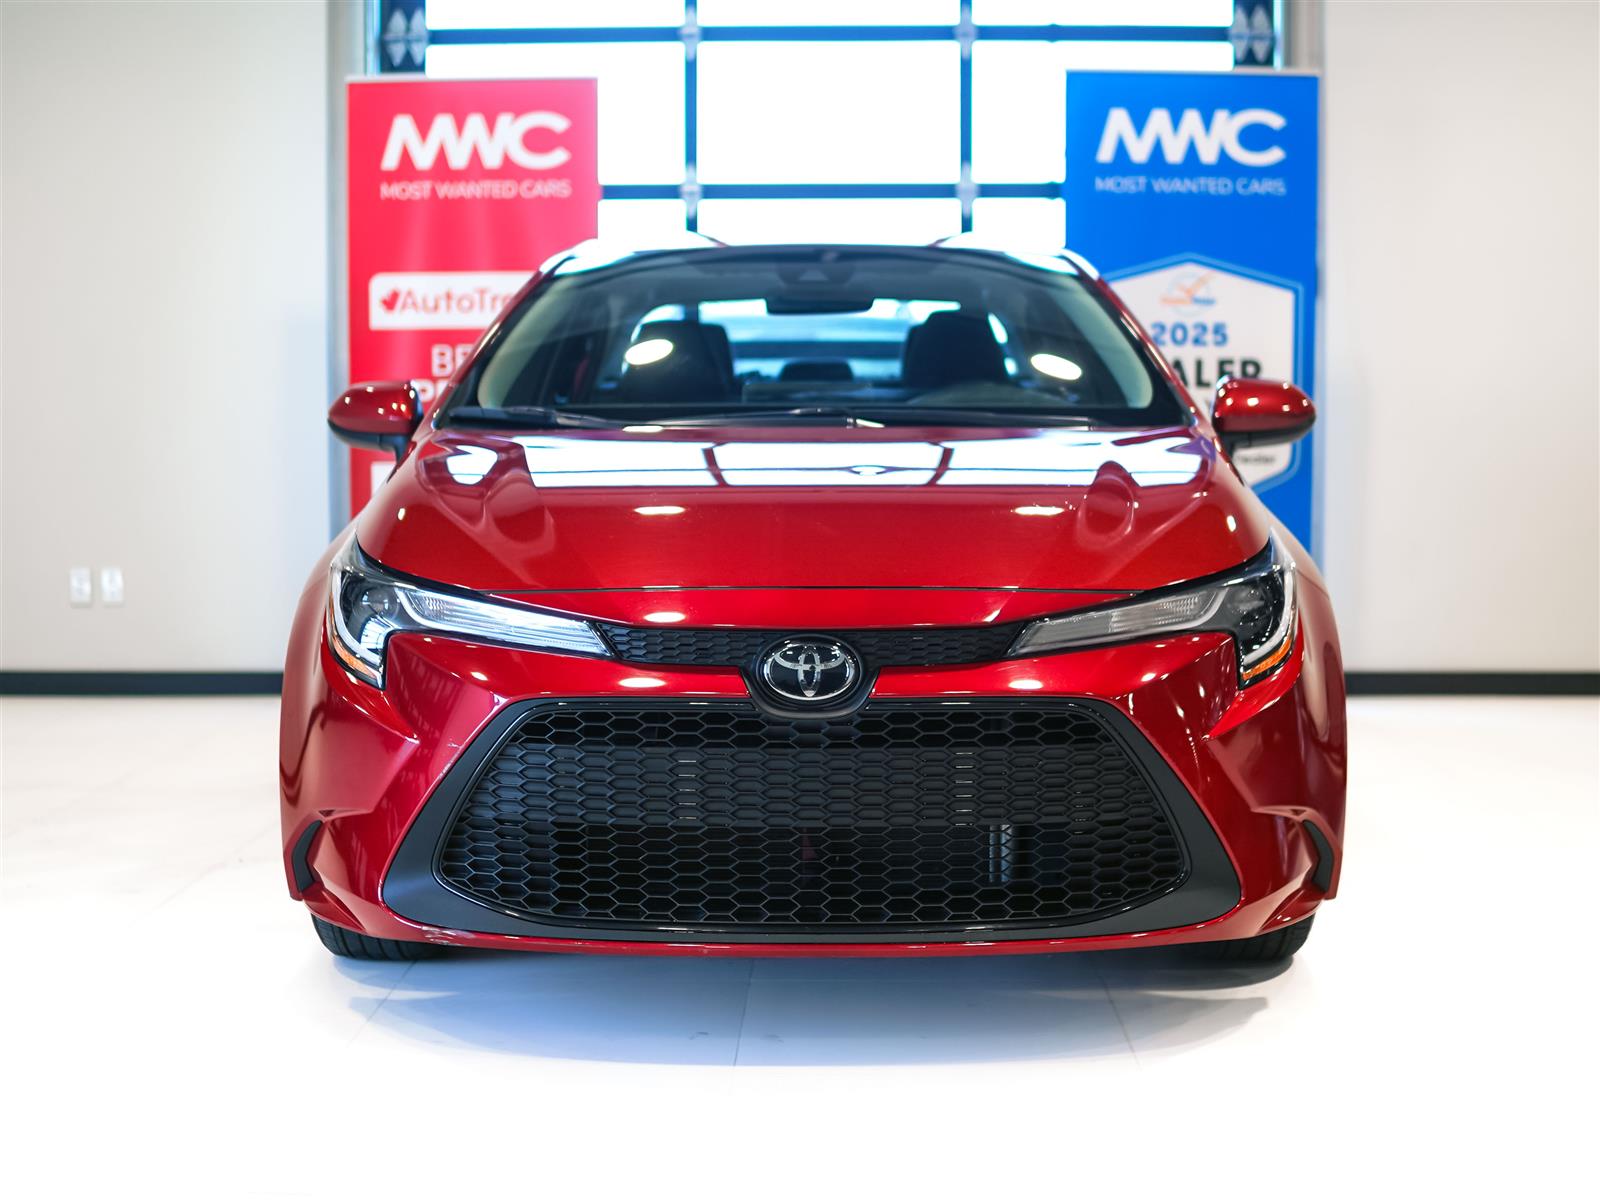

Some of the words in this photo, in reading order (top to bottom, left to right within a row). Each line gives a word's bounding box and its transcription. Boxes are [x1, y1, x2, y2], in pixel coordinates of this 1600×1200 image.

[380, 112, 571, 170] MWC
[1096, 107, 1286, 167] MWC
[380, 181, 432, 200] MOST
[434, 180, 518, 199] WANTED
[519, 179, 572, 199] CARS
[1095, 176, 1146, 193] MOST
[1152, 177, 1232, 195] WANTED
[1236, 178, 1286, 196] CARS
[1151, 322, 1228, 347] 2025
